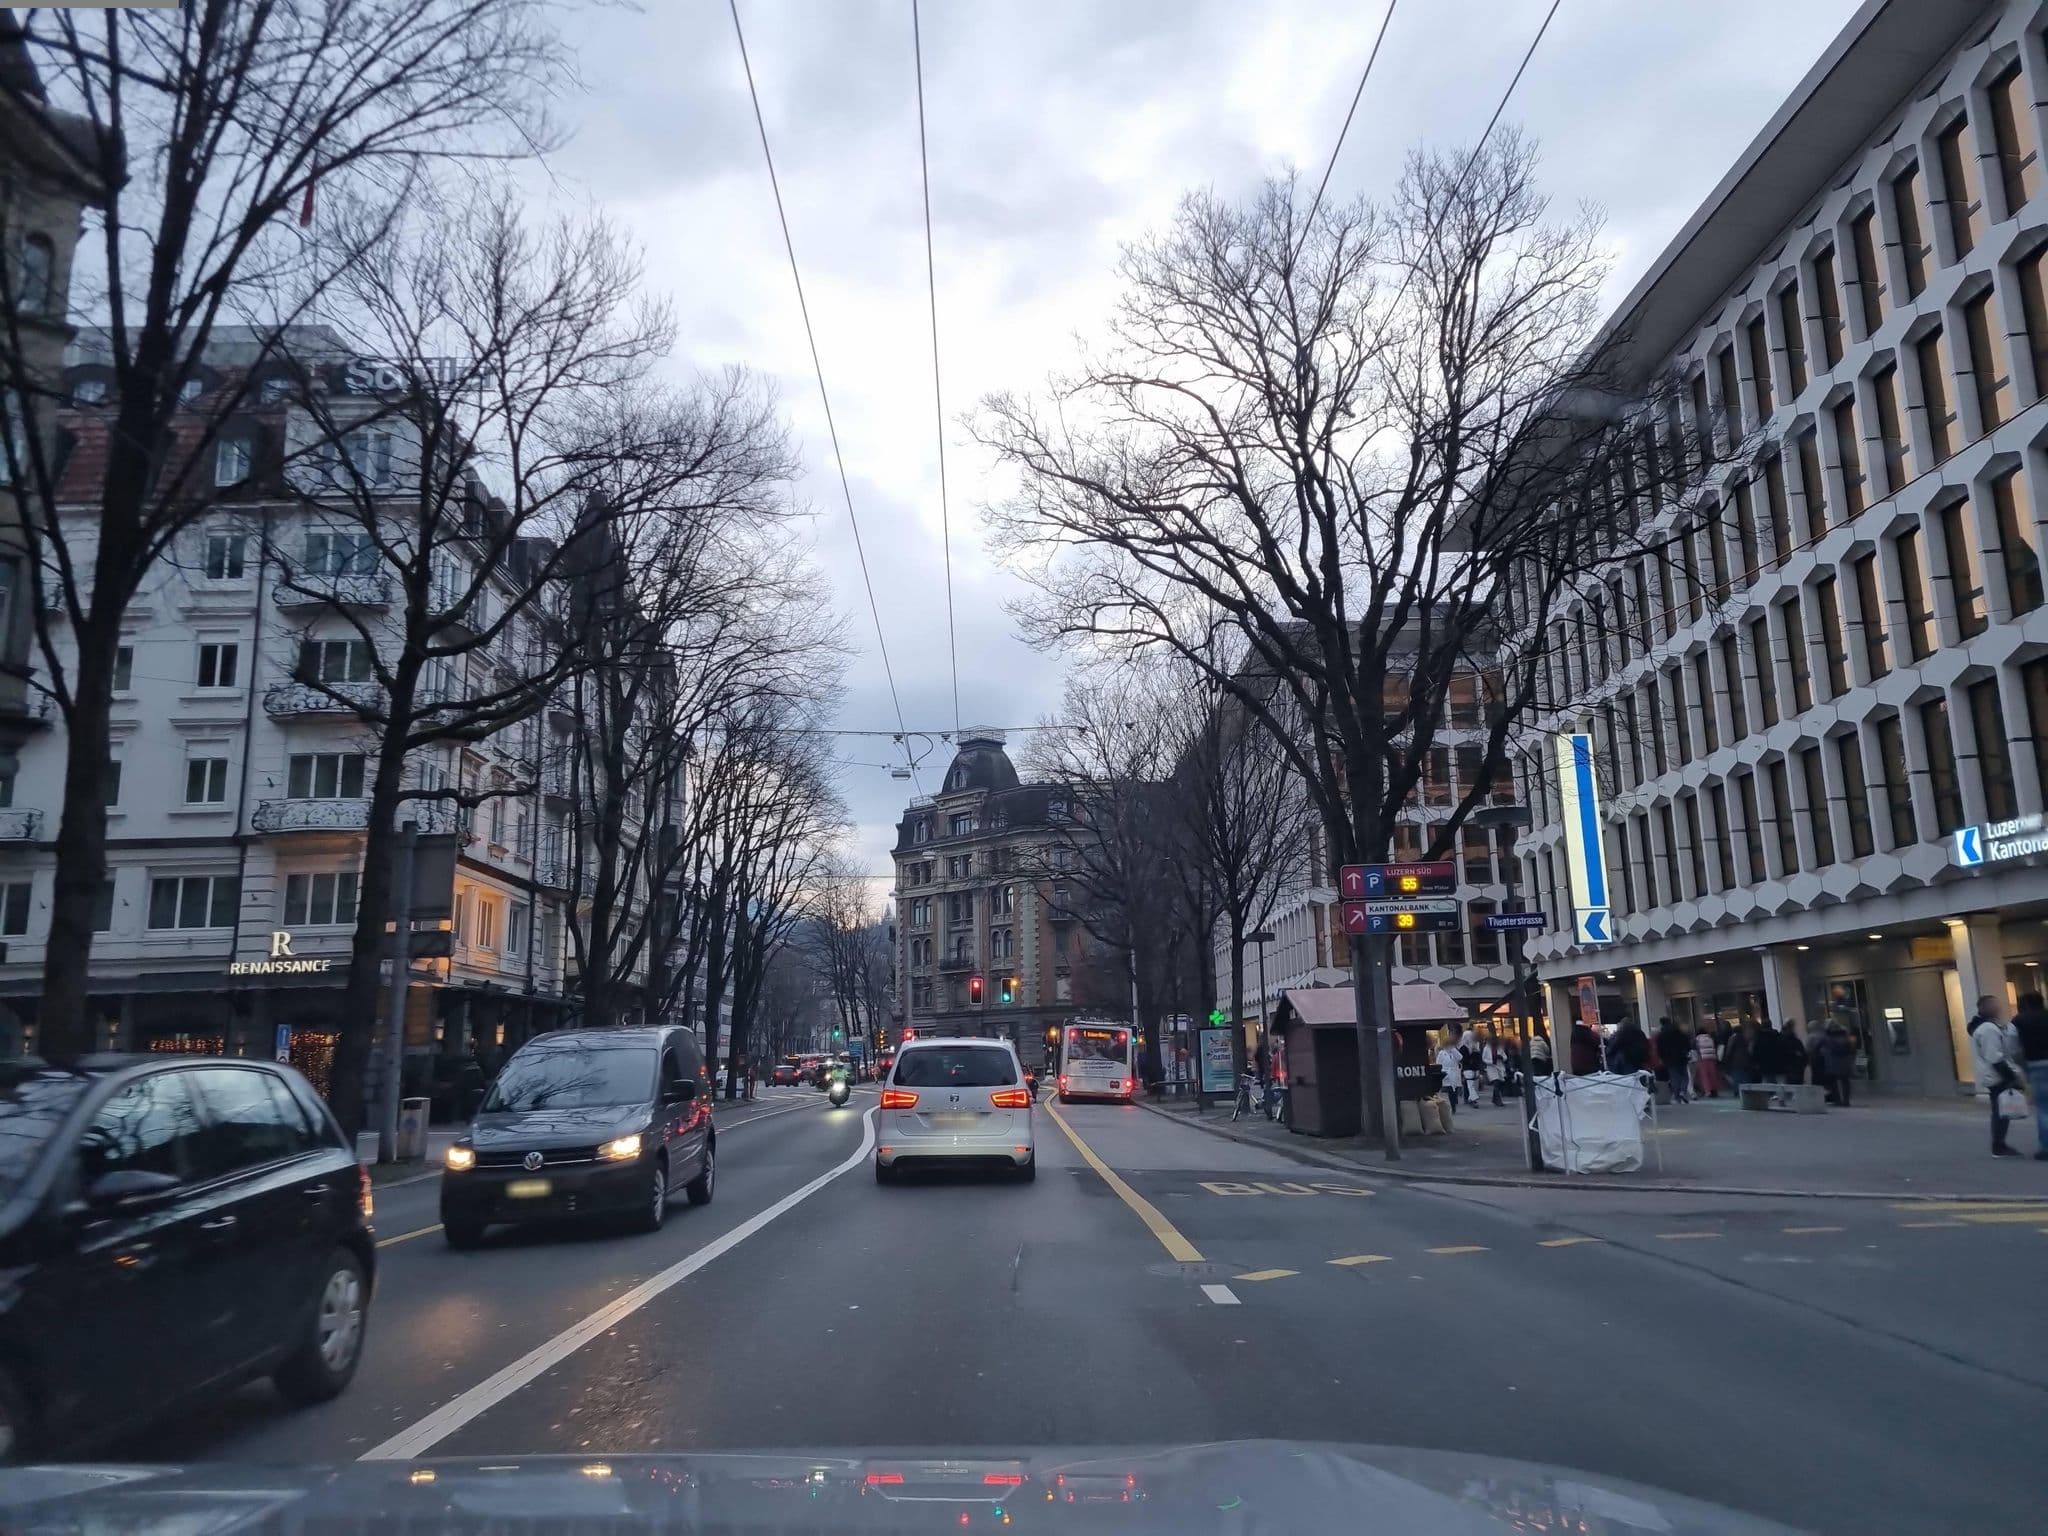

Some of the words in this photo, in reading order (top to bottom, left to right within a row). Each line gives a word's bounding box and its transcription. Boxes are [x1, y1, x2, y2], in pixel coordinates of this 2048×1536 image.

[1416, 867, 1432, 875] SÜD
[1369, 876, 1379, 888] P
[1402, 877, 1417, 890] 55
[1369, 904, 1430, 913] KANTONALBANK
[1373, 919, 1381, 928] P
[1398, 914, 1413, 927] 39
[1488, 916, 1544, 927] Theaterstrasse
[270, 931, 297, 957] R
[230, 960, 331, 975] RENAISSANCE
[1197, 1182, 1377, 1196] BUS
